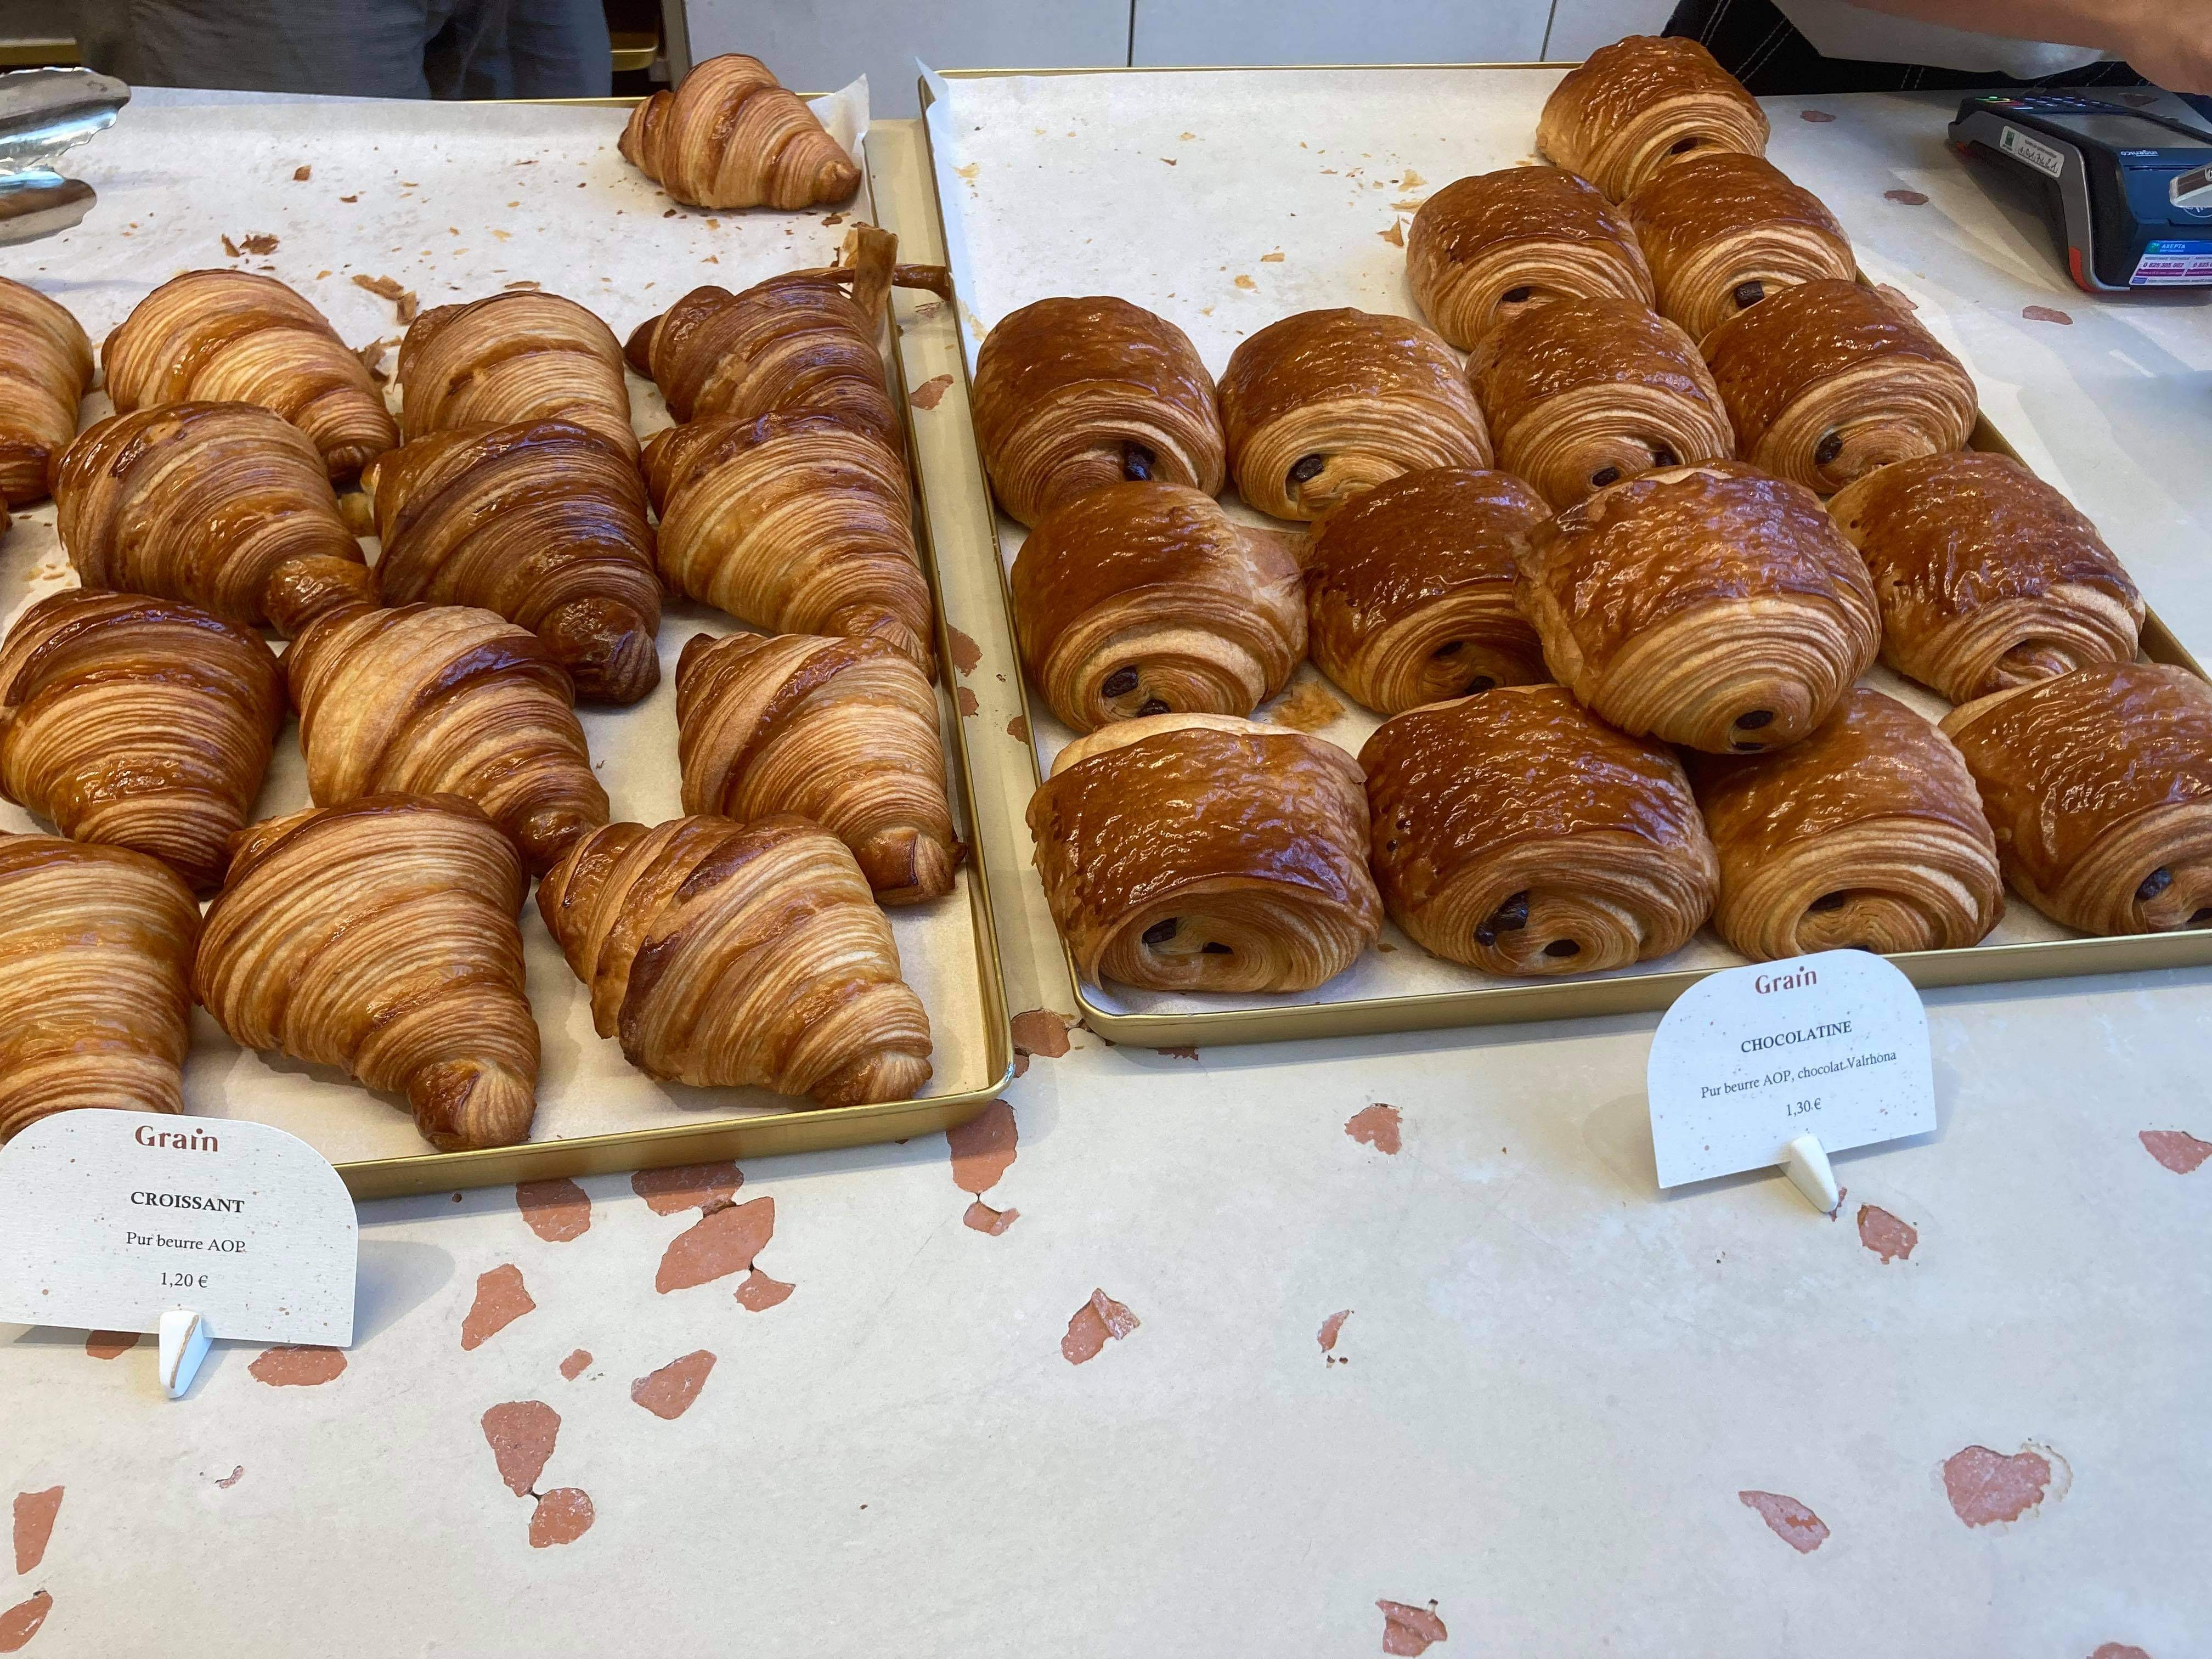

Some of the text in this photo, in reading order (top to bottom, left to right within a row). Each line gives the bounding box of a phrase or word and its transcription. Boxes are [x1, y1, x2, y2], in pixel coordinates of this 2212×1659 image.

[1755, 966, 1816, 994] Grain
[1741, 1020, 1852, 1053] CHOCOLATINE
[1701, 1052, 1897, 1098] Pur beurre AOP, chocolat Valrhona
[1786, 1098, 1822, 1117] 1,30 €
[135, 1125, 218, 1152] Grain
[131, 1191, 245, 1213] CROISSANT
[126, 1232, 153, 1246] Pur
[156, 1234, 203, 1250] beurre
[160, 1272, 208, 1288] 1,20 €
